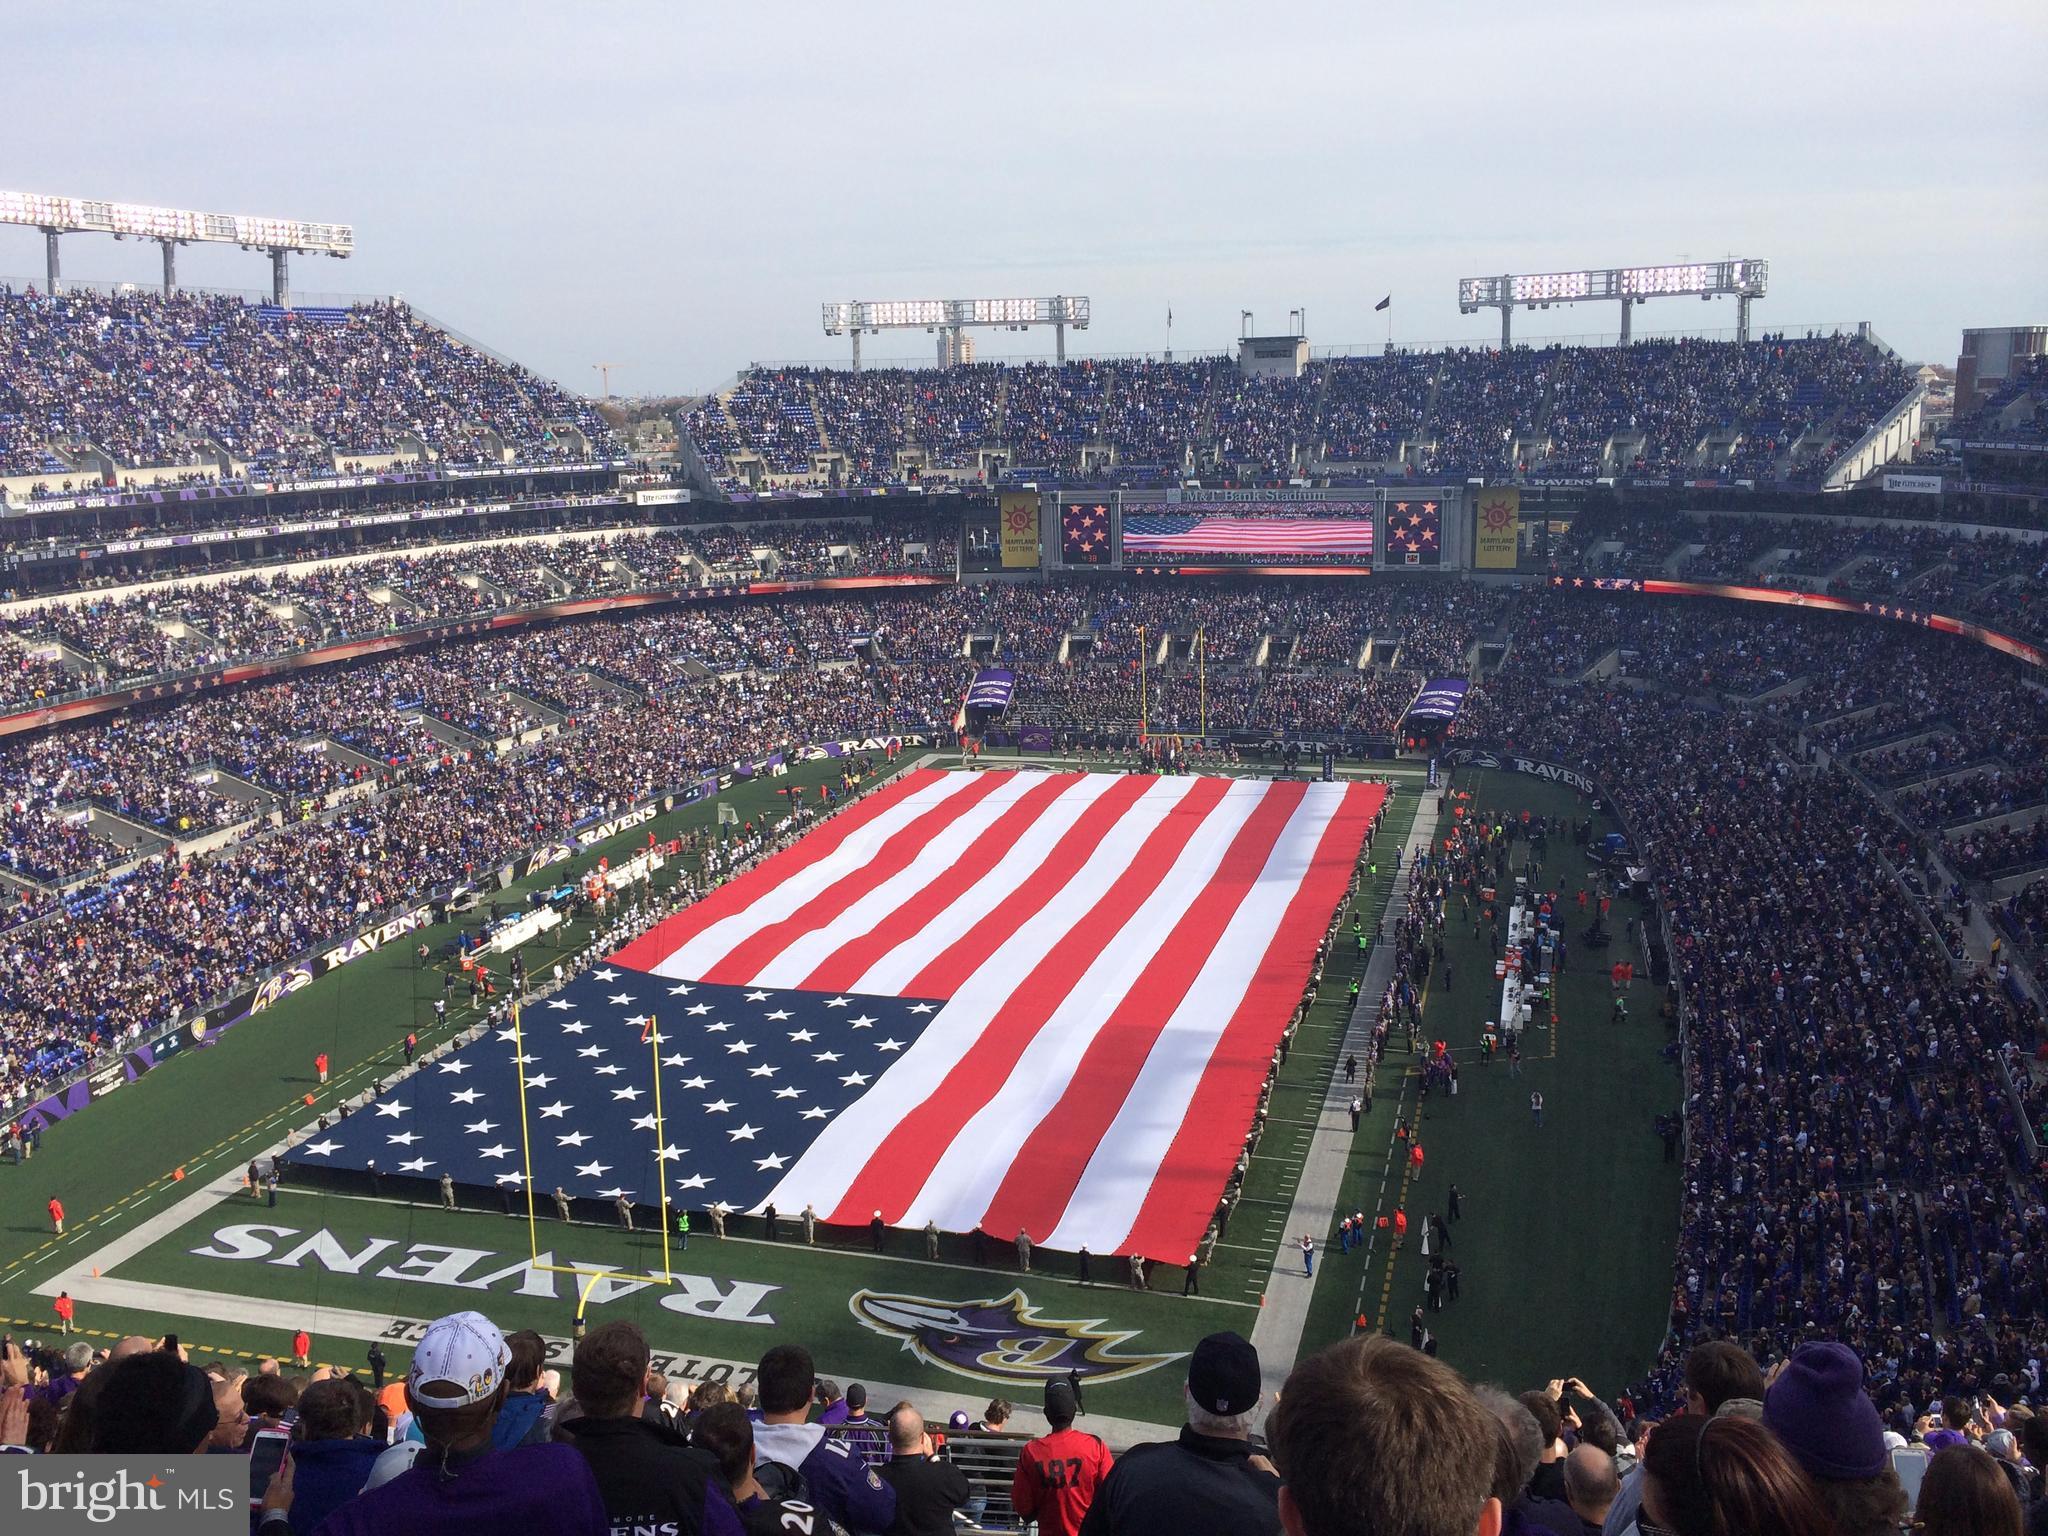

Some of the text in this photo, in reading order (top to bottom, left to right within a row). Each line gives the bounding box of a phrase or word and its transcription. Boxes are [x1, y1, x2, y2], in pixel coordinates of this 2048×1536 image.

[278, 477, 377, 492] AFC CHAMPIONS 2000 2012
[1534, 478, 1593, 487] RAVENS
[1187, 489, 1326, 502] M&T Bank Stadium
[86, 498, 106, 507] 2012
[444, 507, 463, 516] LEWIS
[489, 504, 511, 512] LEWIS
[191, 534, 225, 543] ARTHUR
[237, 528, 268, 538] MODELL
[143, 539, 173, 549] HONOR
[973, 680, 1013, 688] GEICO
[1420, 690, 1463, 698] GEICO
[967, 697, 1006, 705] GEICO
[1410, 707, 1454, 716] GEICO
[1513, 759, 1595, 794] RAVENS
[576, 804, 658, 846] RAVENS
[189, 1223, 784, 1325] RAVENS
[650, 1355, 758, 1388] LUTE
[780, 1499, 815, 1536] 20
